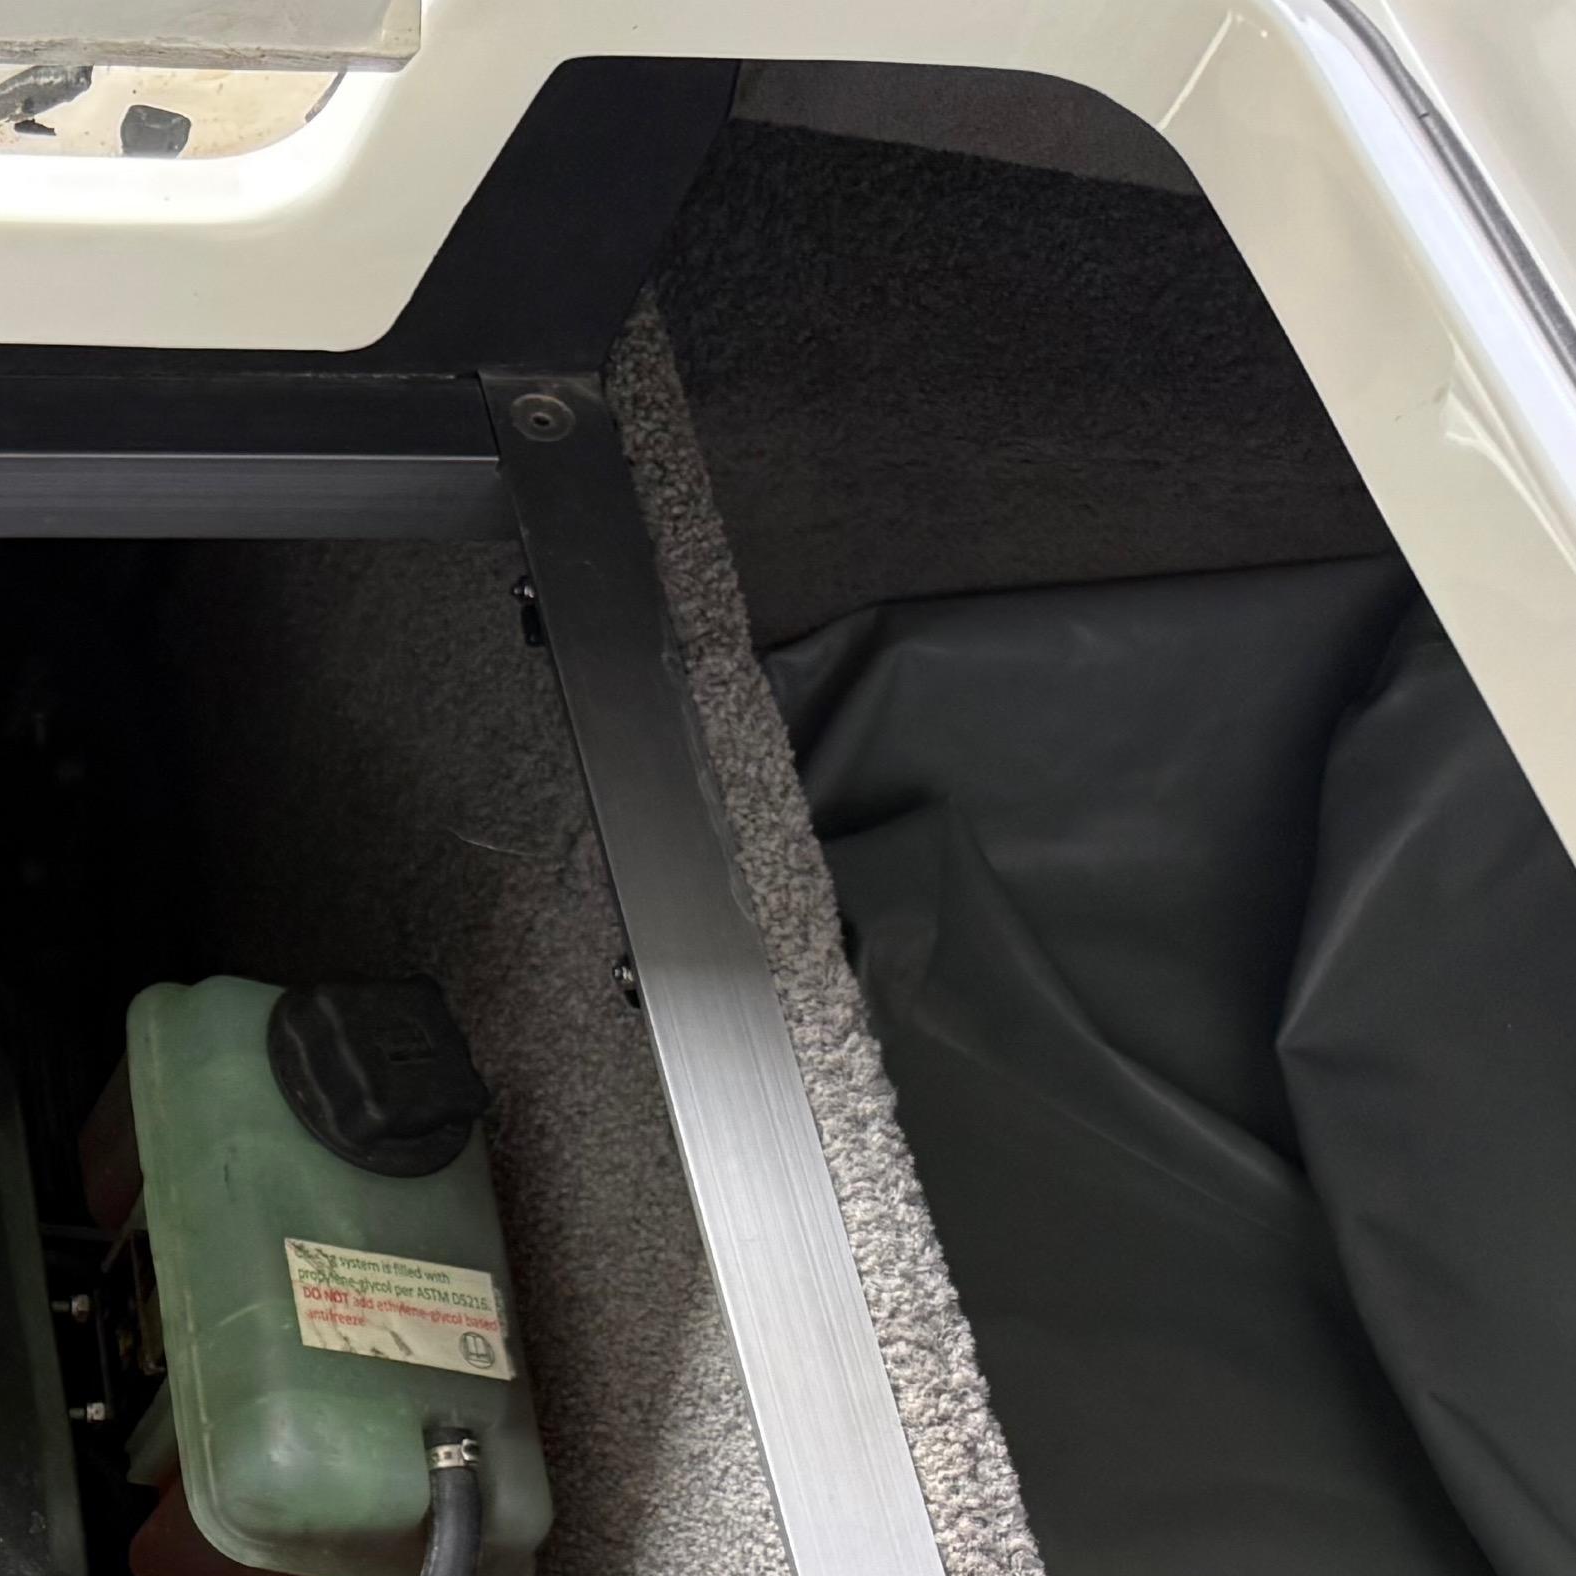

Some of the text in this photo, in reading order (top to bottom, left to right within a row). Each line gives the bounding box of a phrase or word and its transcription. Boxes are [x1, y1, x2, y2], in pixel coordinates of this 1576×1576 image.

[338, 1256, 380, 1273] system
[393, 1261, 422, 1280] filled
[424, 1270, 451, 1285] with
[302, 1286, 322, 1301] DO
[324, 1289, 349, 1305] NOT
[353, 1296, 374, 1310] add
[464, 1312, 499, 1332] based
[393, 1285, 414, 1298] per
[417, 1286, 450, 1304] ASTM
